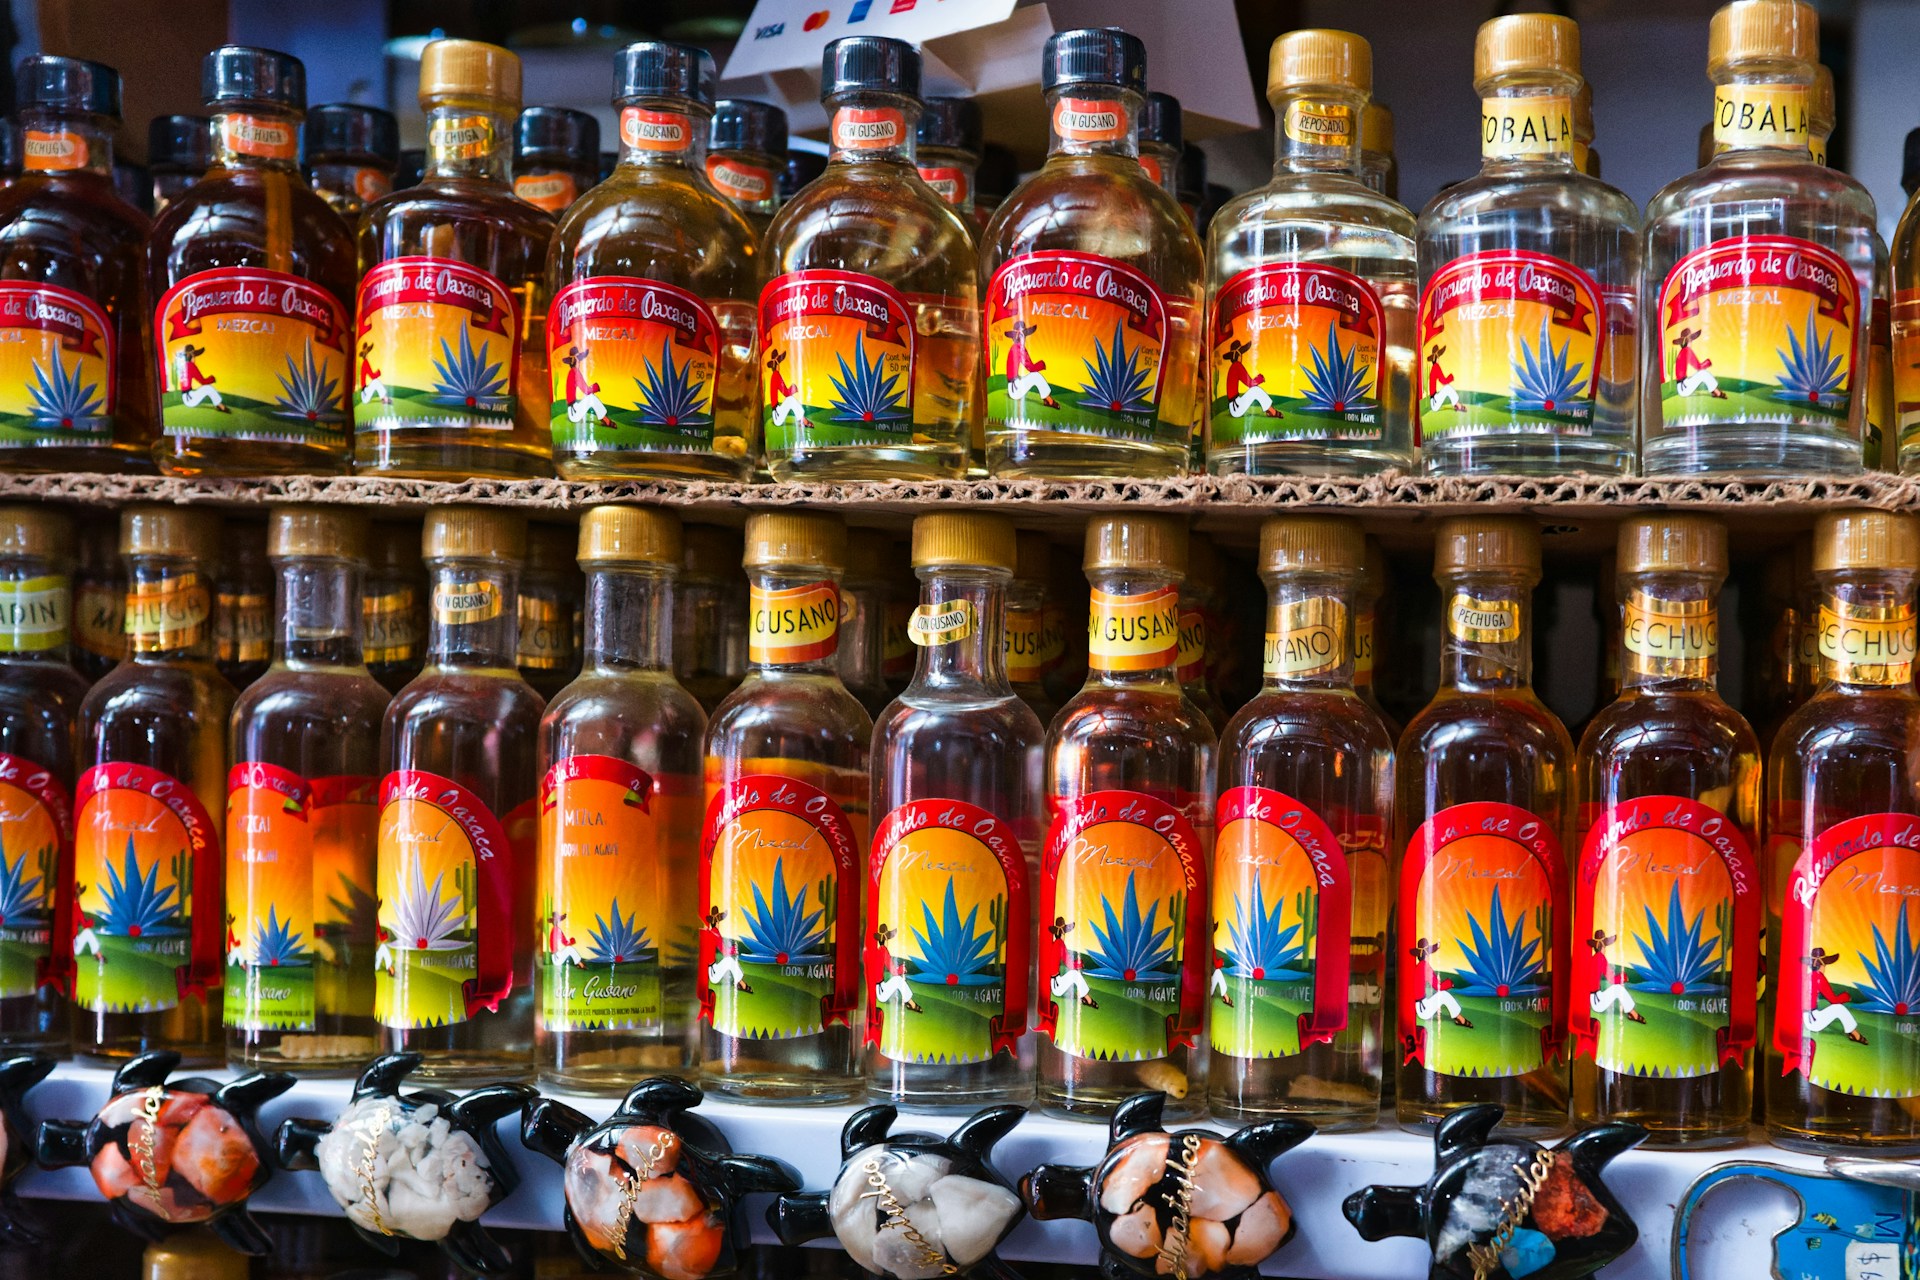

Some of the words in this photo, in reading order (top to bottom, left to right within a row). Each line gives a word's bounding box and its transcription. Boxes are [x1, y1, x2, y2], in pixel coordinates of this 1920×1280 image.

[755, 22, 785, 40] VISA
[643, 124, 681, 139] GUSANO
[858, 122, 894, 139] GUSANO
[1079, 113, 1115, 128] GUSANO
[1299, 115, 1345, 133] REPOSADO
[368, 270, 410, 300] cuerdo
[414, 268, 433, 291] de
[435, 269, 493, 309] Oaxaca
[1681, 256, 1756, 303] Recuerdo
[1760, 251, 1781, 274] de
[1786, 252, 1839, 295] Oaxaca
[182, 282, 254, 324] Recuerdo
[258, 284, 278, 307] de
[281, 286, 331, 325] Oaxaca
[1003, 264, 1069, 308] Recuerdo
[1072, 266, 1091, 290] de
[1095, 269, 1149, 317] Oaxaca
[1281, 275, 1300, 301] de
[1304, 274, 1360, 314] Oaxaca
[1432, 265, 1491, 323] Recuerdo
[1494, 265, 1515, 287] de
[1518, 263, 1577, 306] Oaxaca
[1716, 290, 1782, 306] MEZCAL
[3, 298, 20, 316] de
[26, 293, 84, 331] Oaxaca
[382, 303, 434, 319] MEZCAL
[558, 293, 614, 335] Recuerdo
[618, 294, 636, 314] de
[641, 291, 697, 332] Oaxaca
[811, 285, 829, 308] de
[833, 285, 890, 323] Oaxaca
[1031, 301, 1090, 320] MEZCAL
[1457, 303, 1516, 322] MEZCAL
[582, 327, 637, 341] MEZCAL
[782, 324, 832, 341] MEZCAL
[1246, 313, 1303, 331] MEZCAL
[1360, 412, 1375, 424] AGAVE
[453, 592, 488, 609] GUSANO
[755, 598, 835, 634] GUSANO
[1457, 608, 1506, 627] PECHUGA
[117, 768, 143, 789] de
[150, 780, 206, 850] Oaxaca
[405, 776, 430, 798] de
[437, 789, 495, 861] Oaxaca
[564, 808, 607, 827] MEZCA
[726, 822, 819, 851] Mezcal
[769, 783, 797, 805] de
[805, 795, 853, 870] Oaxaca
[594, 843, 619, 857] AGAVE
[937, 806, 965, 828] de
[973, 818, 1022, 892] Oaxaca
[1071, 837, 1168, 869] Mezcal
[1118, 799, 1147, 823] de
[1154, 814, 1198, 891] Oaxaca
[1221, 841, 1296, 867] ezcal
[1245, 795, 1271, 819] de
[1279, 810, 1335, 888] Oaxaca
[1663, 803, 1692, 827] de
[1700, 816, 1749, 896] Oaxaca
[1436, 853, 1534, 880] Mezcal
[1613, 844, 1716, 876] Mezcal
[1793, 825, 1882, 911] Recuerdo
[1893, 823, 1920, 847] de
[154, 940, 185, 956] AGAVE
[806, 963, 834, 979] AGAVE
[582, 975, 638, 1004] Gusano
[951, 989, 970, 1001] 00%
[973, 987, 1001, 1003] AGAVE
[1148, 986, 1176, 1002] AGAVE
[1700, 997, 1727, 1014] AGAVE
